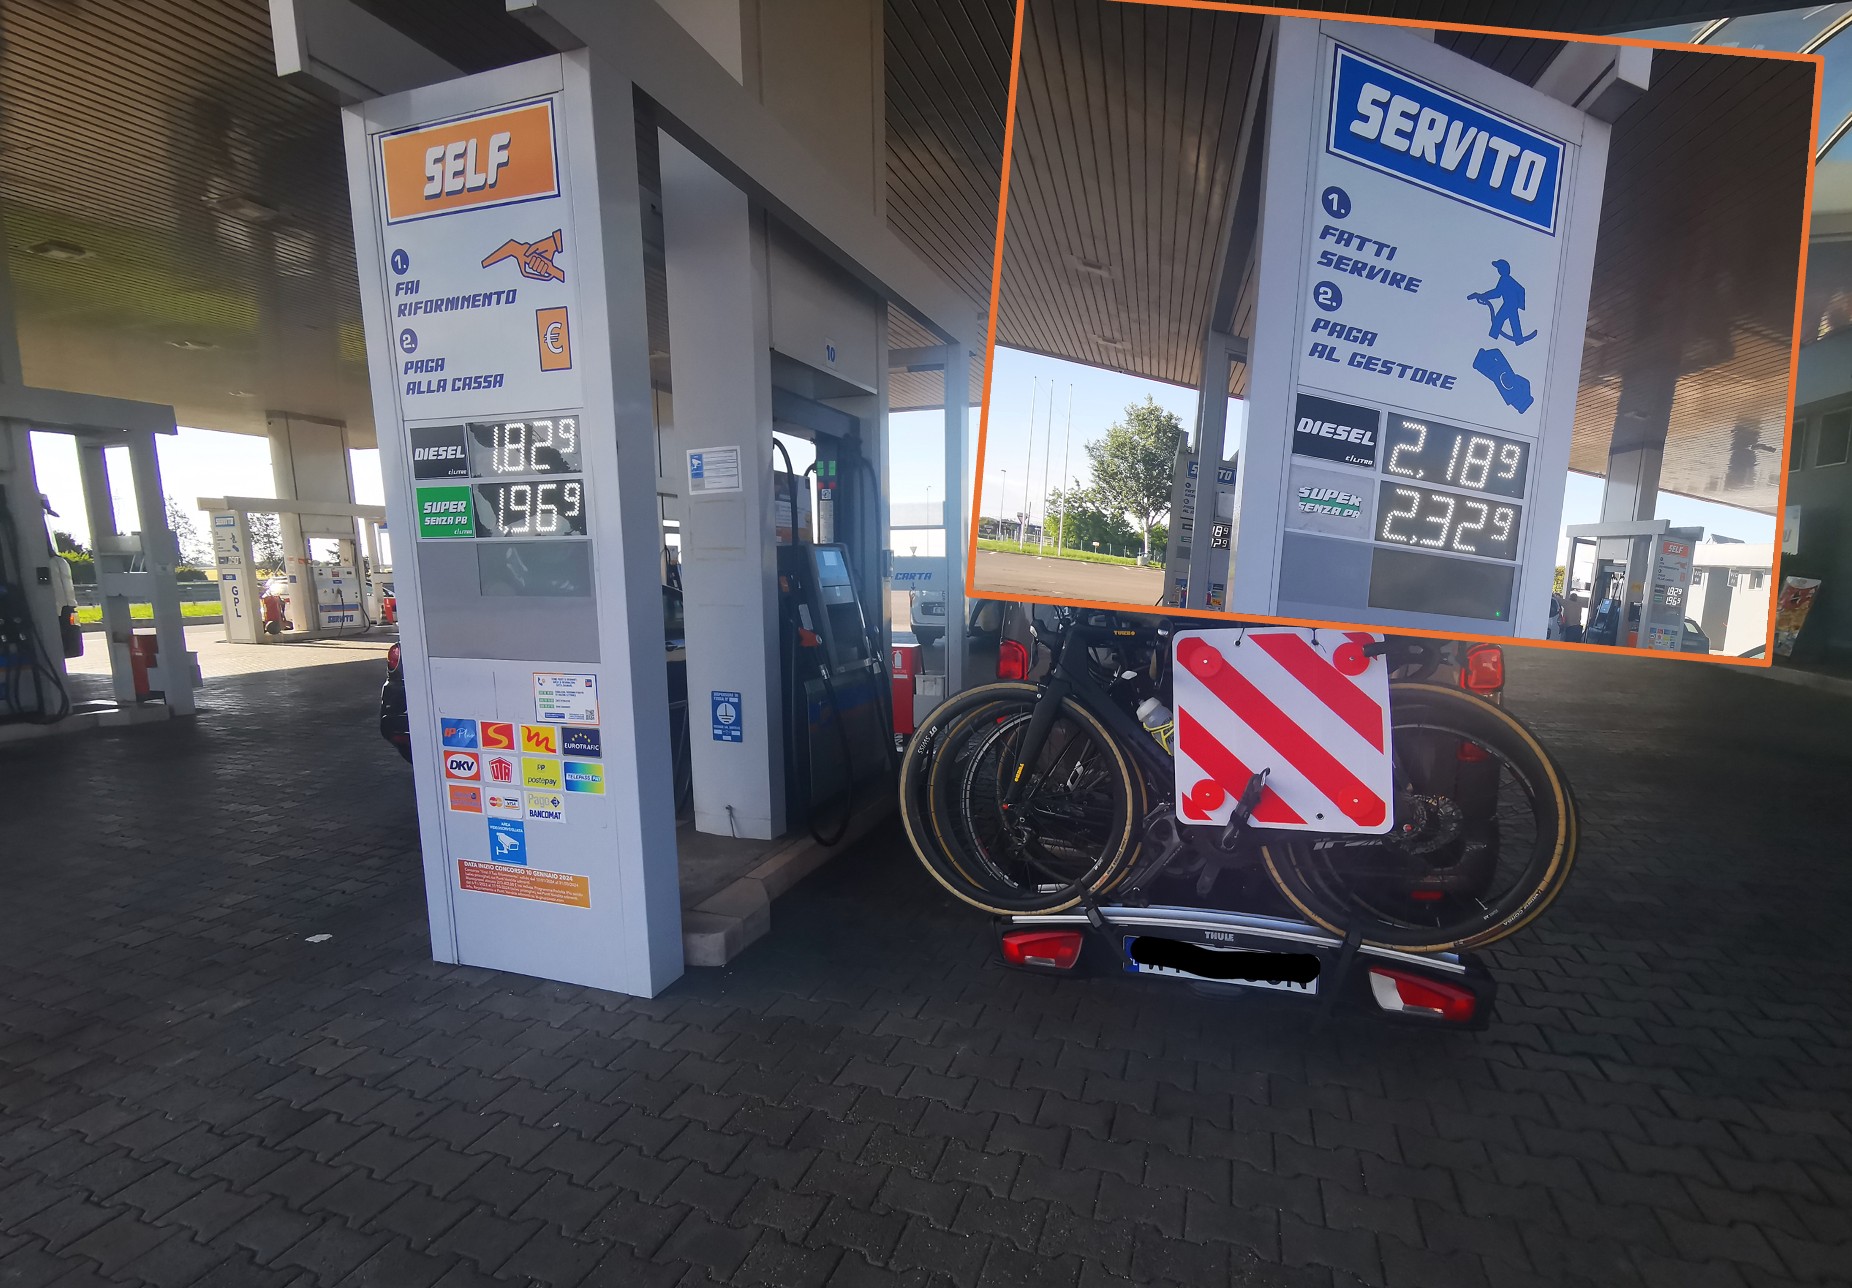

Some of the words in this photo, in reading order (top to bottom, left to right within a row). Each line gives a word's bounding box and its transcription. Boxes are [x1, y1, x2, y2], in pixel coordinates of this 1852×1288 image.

[1350, 82, 1547, 202] SERVITO
[424, 132, 511, 200] SELF
[1319, 224, 1398, 261] FATTI
[1317, 250, 1422, 293] SERVIRE
[395, 280, 420, 297] FAI
[397, 289, 517, 317] RIFORNIMENTO
[1311, 318, 1378, 347] PAGA
[826, 344, 836, 363] 10
[404, 358, 445, 375] PAGA
[1308, 342, 1341, 363] AL
[1347, 351, 1457, 390] GESTORE
[406, 378, 447, 395] ALLA
[451, 374, 504, 392] CASSA
[1297, 417, 1375, 446] DIESEL
[414, 446, 465, 461] DIESEL
[424, 501, 467, 514] SUPER
[1298, 502, 1341, 516] SENZA
[424, 516, 454, 526] SENZA
[455, 516, 468, 525] PB
[1668, 544, 1683, 553] SELF
[895, 572, 932, 580] CARTA
[231, 585, 242, 618] GPL
[929, 725, 938, 737] DT
[564, 743, 600, 751] EUROTRAFIC
[917, 735, 931, 754] SWISS
[450, 760, 474, 771] DKV
[490, 762, 511, 783] UTA
[527, 776, 557, 786] postepay
[528, 794, 549, 808] Pago
[529, 809, 561, 820] BANCOMAT
[478, 863, 495, 871] INIZIO
[495, 865, 525, 875] CONCORSO
[533, 870, 558, 880] GENNAIO
[1204, 931, 1234, 942] THULE
